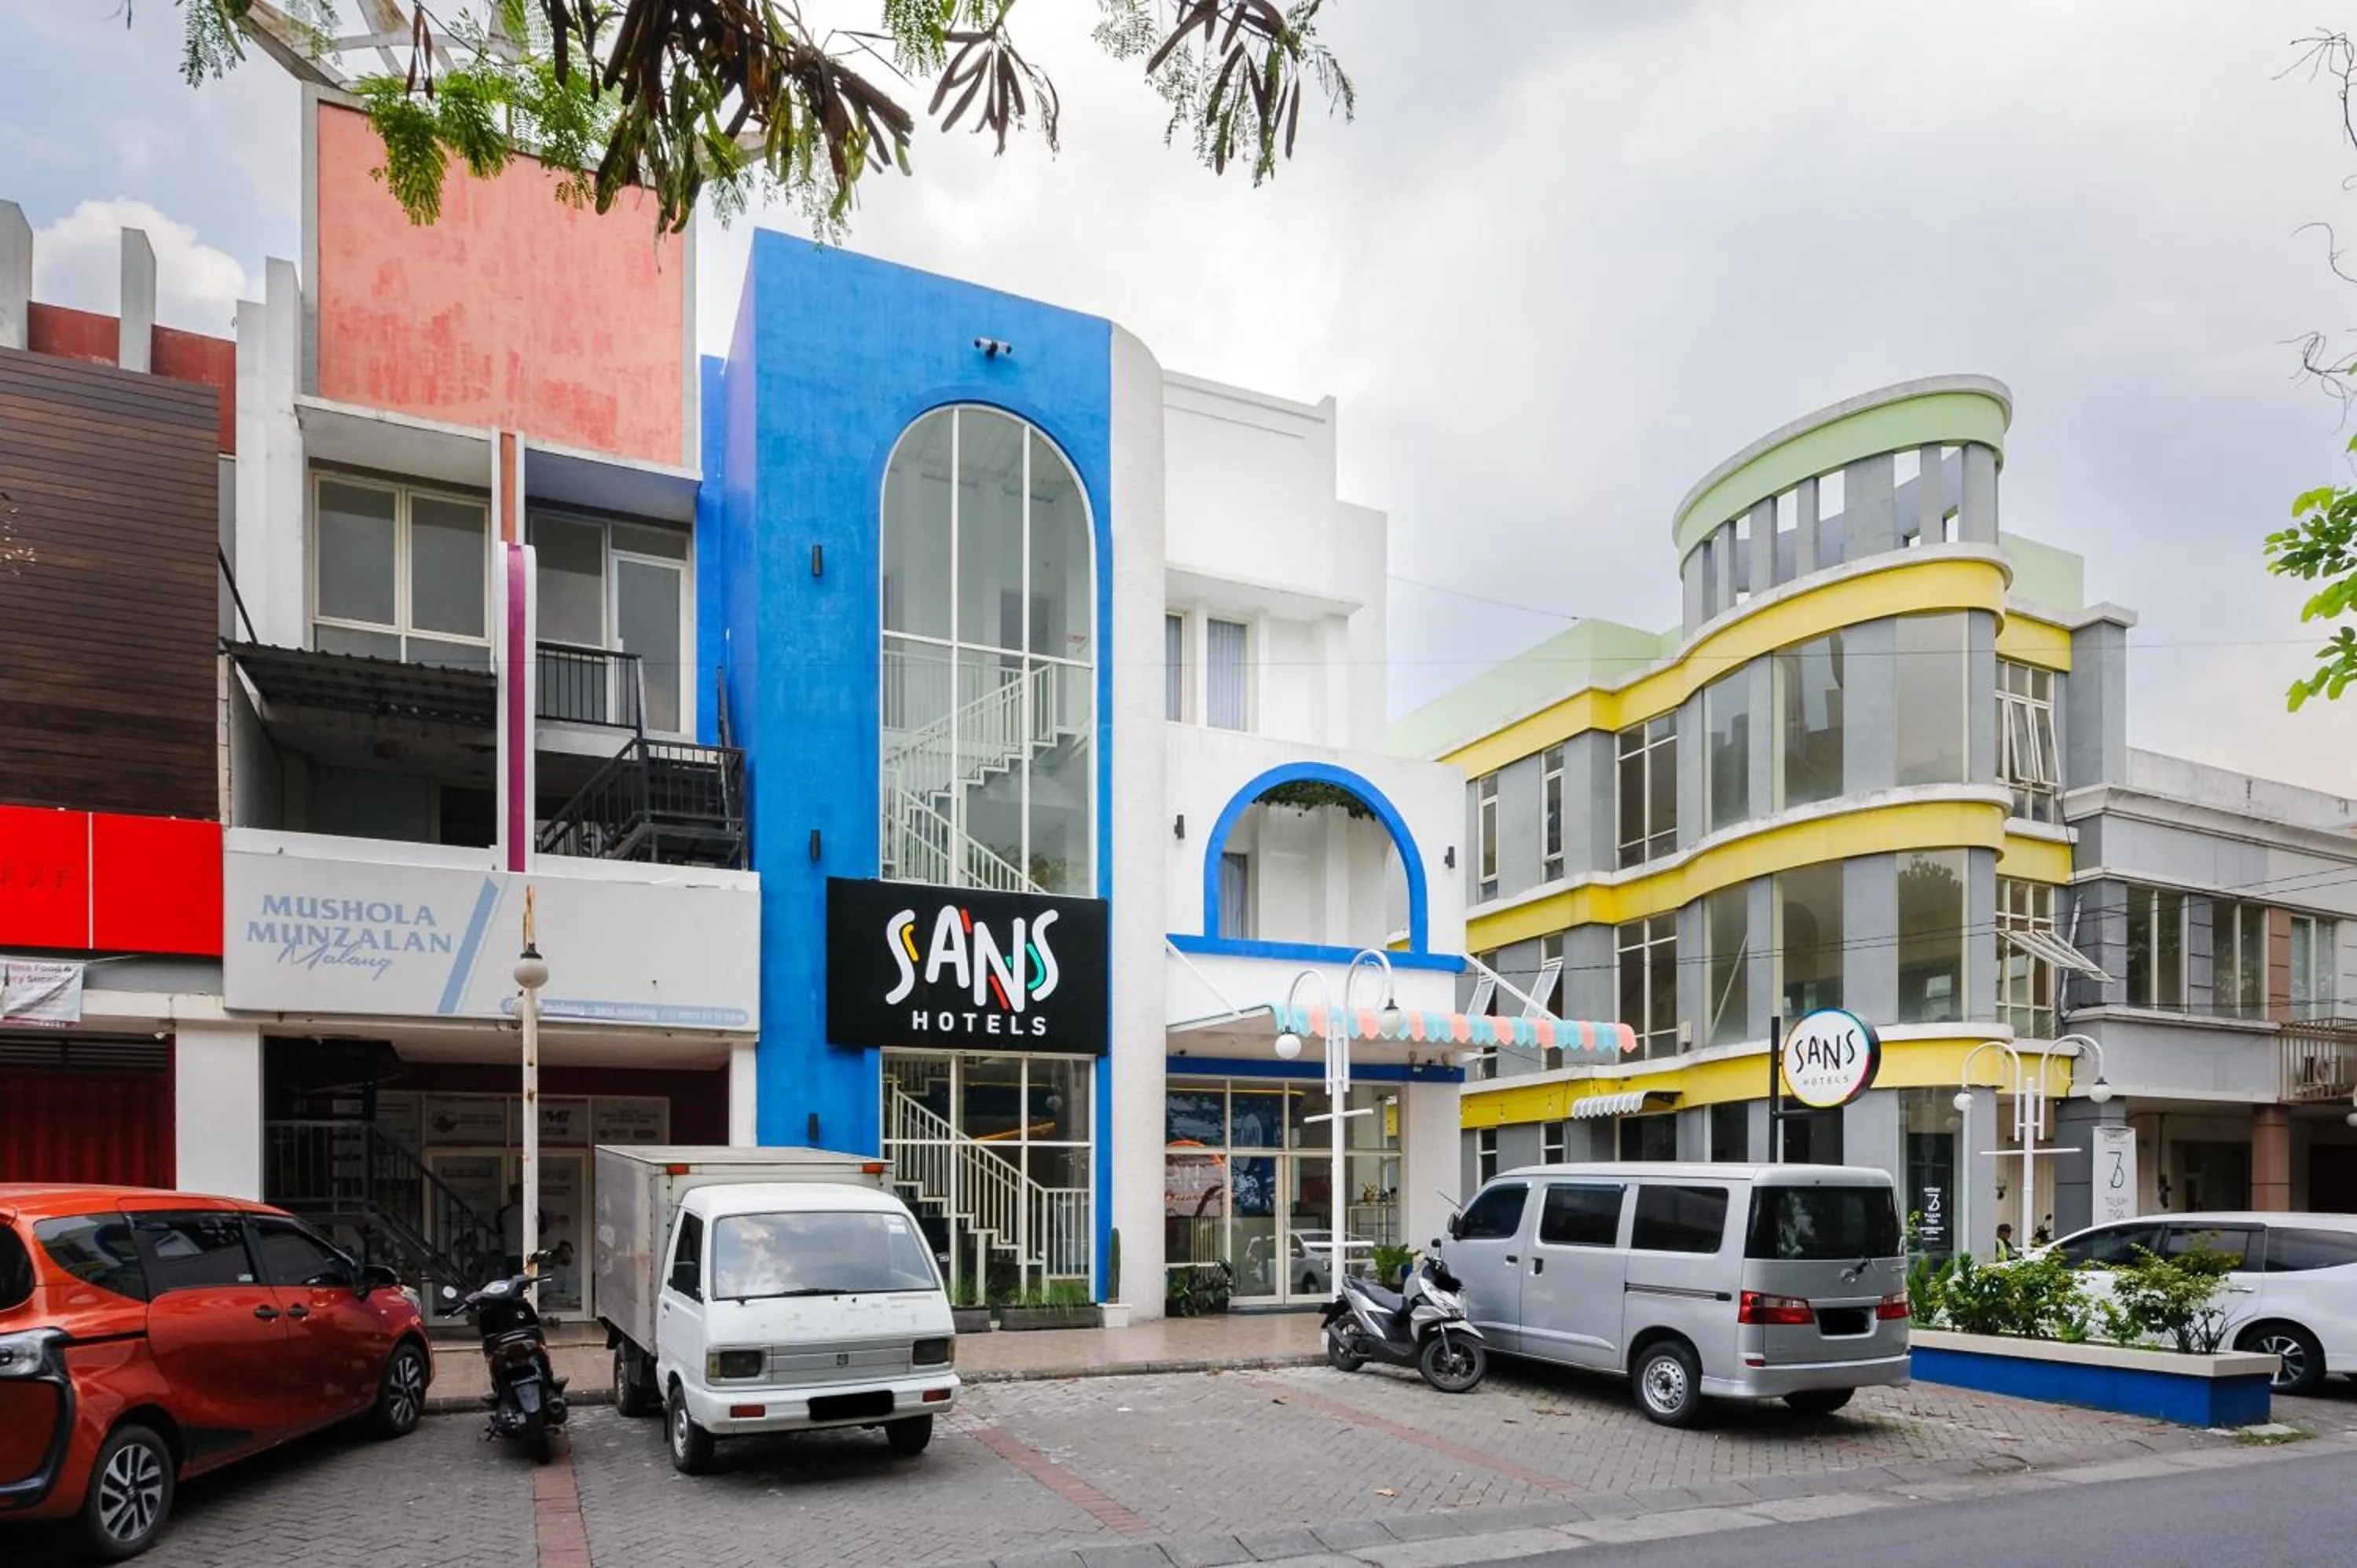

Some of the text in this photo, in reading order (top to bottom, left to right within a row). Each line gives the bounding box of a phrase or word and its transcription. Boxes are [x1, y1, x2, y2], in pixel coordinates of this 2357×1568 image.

[262, 894, 437, 926] MUSHOLA
[246, 921, 452, 954] MUNZALAN
[277, 938, 394, 981] Malang
[885, 905, 1059, 1013] SANS
[911, 1010, 1047, 1036] HOTELS
[1795, 1029, 1855, 1074] SANS
[1802, 1075, 1849, 1086] HOTELS
